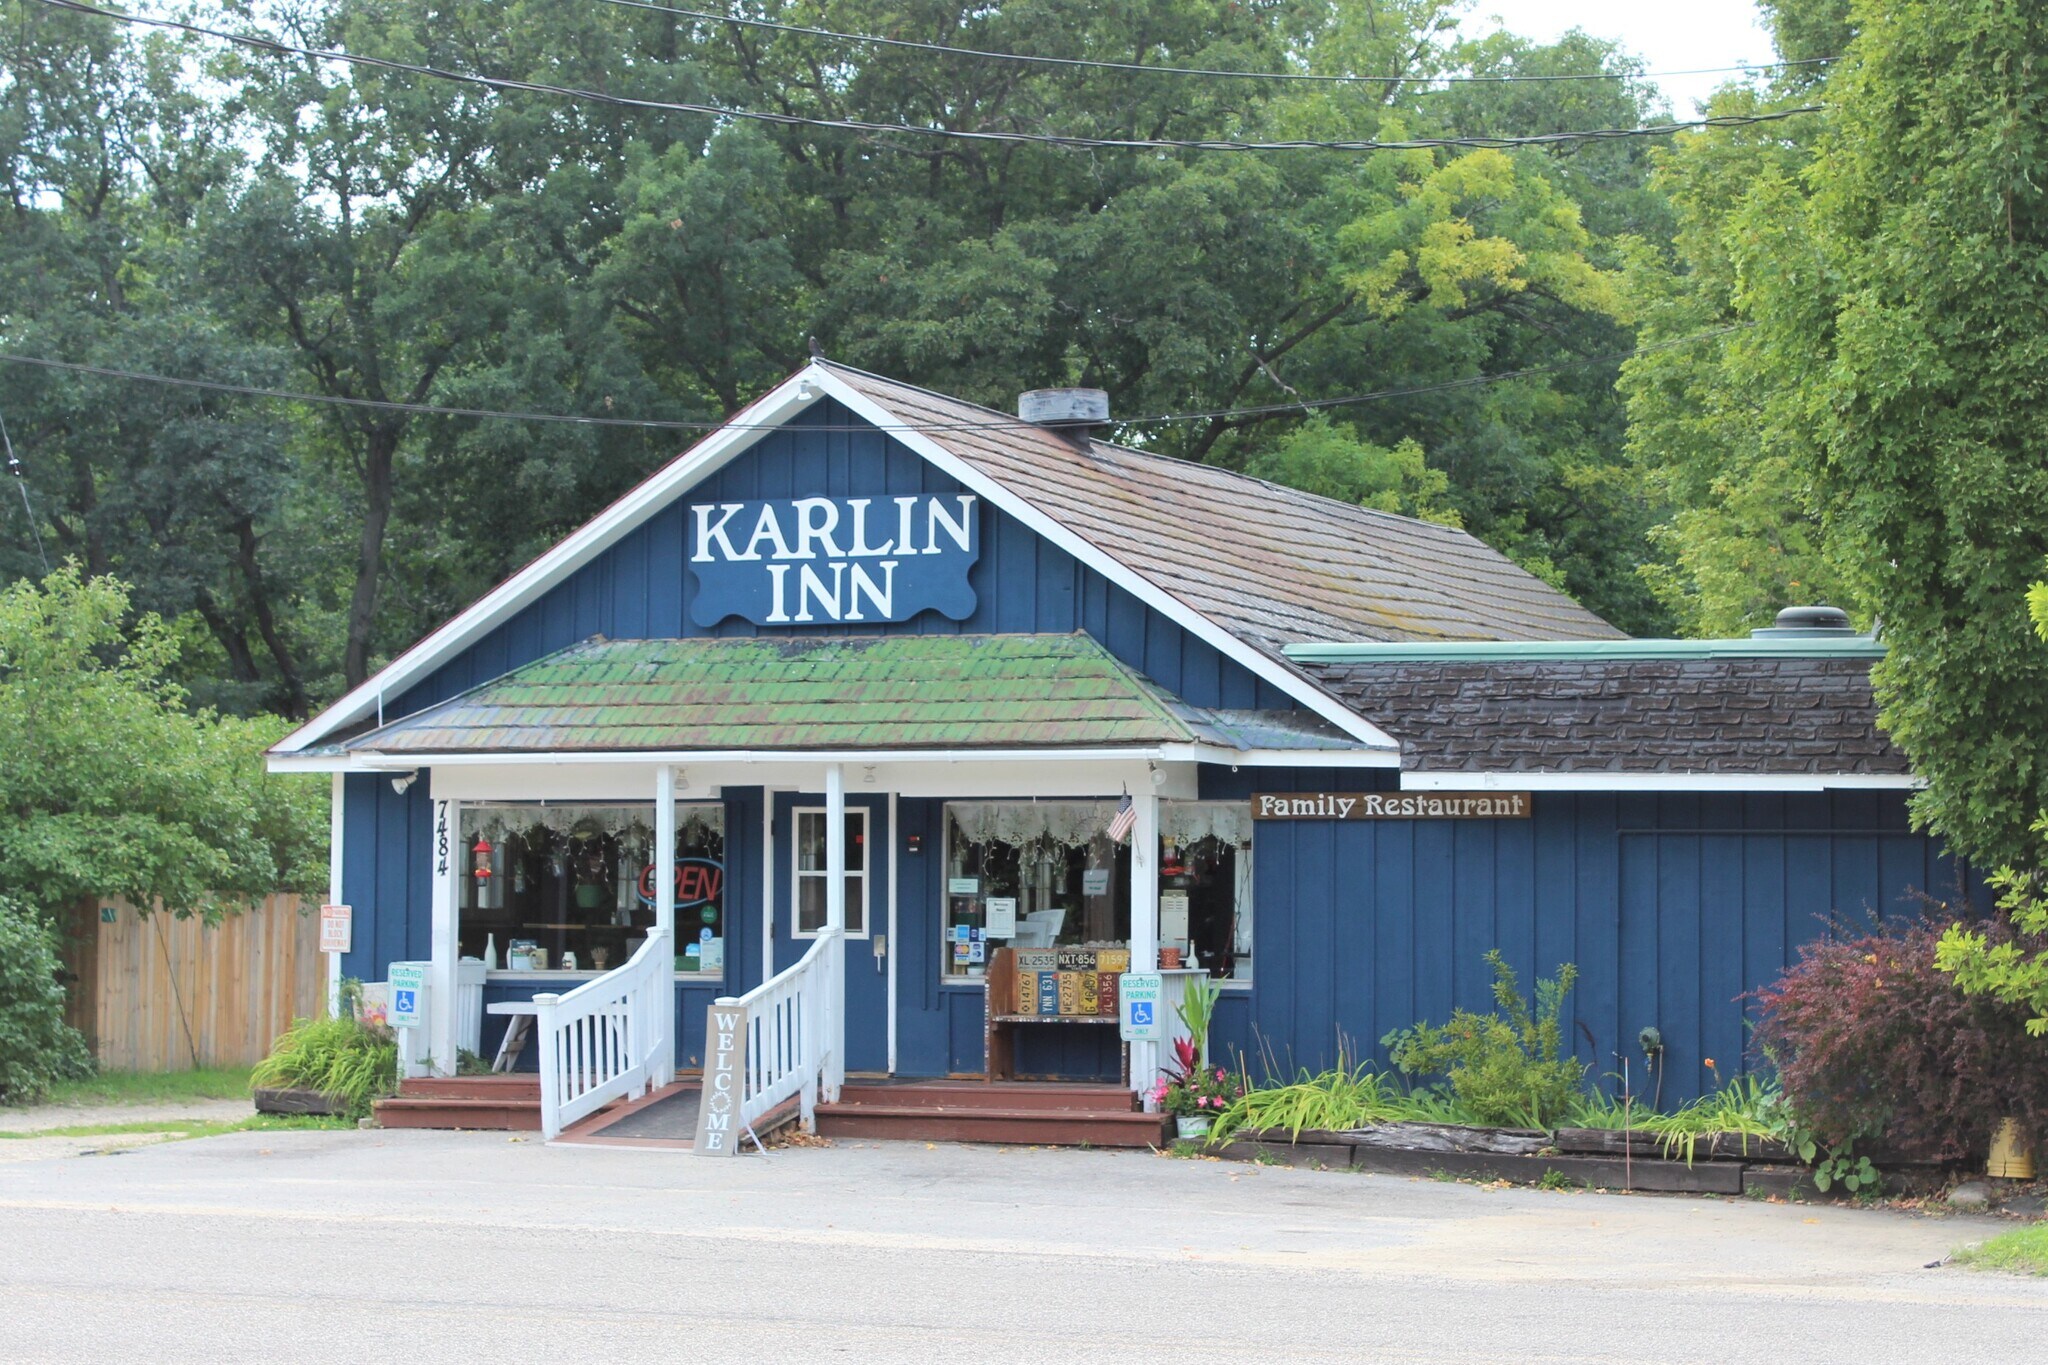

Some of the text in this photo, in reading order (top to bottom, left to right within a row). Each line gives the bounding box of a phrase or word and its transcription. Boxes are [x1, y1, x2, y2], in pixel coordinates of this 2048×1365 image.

[691, 495, 977, 562] KARLIN
[766, 561, 899, 622] INN
[1259, 794, 1524, 818] Family Restaurant
[436, 799, 449, 876] 7484
[391, 968, 422, 978] RESERVED
[393, 979, 419, 988] PARKING
[1122, 979, 1160, 988] RESERVED
[1126, 990, 1157, 999] PARKING
[705, 1012, 741, 1151] WELCOME
